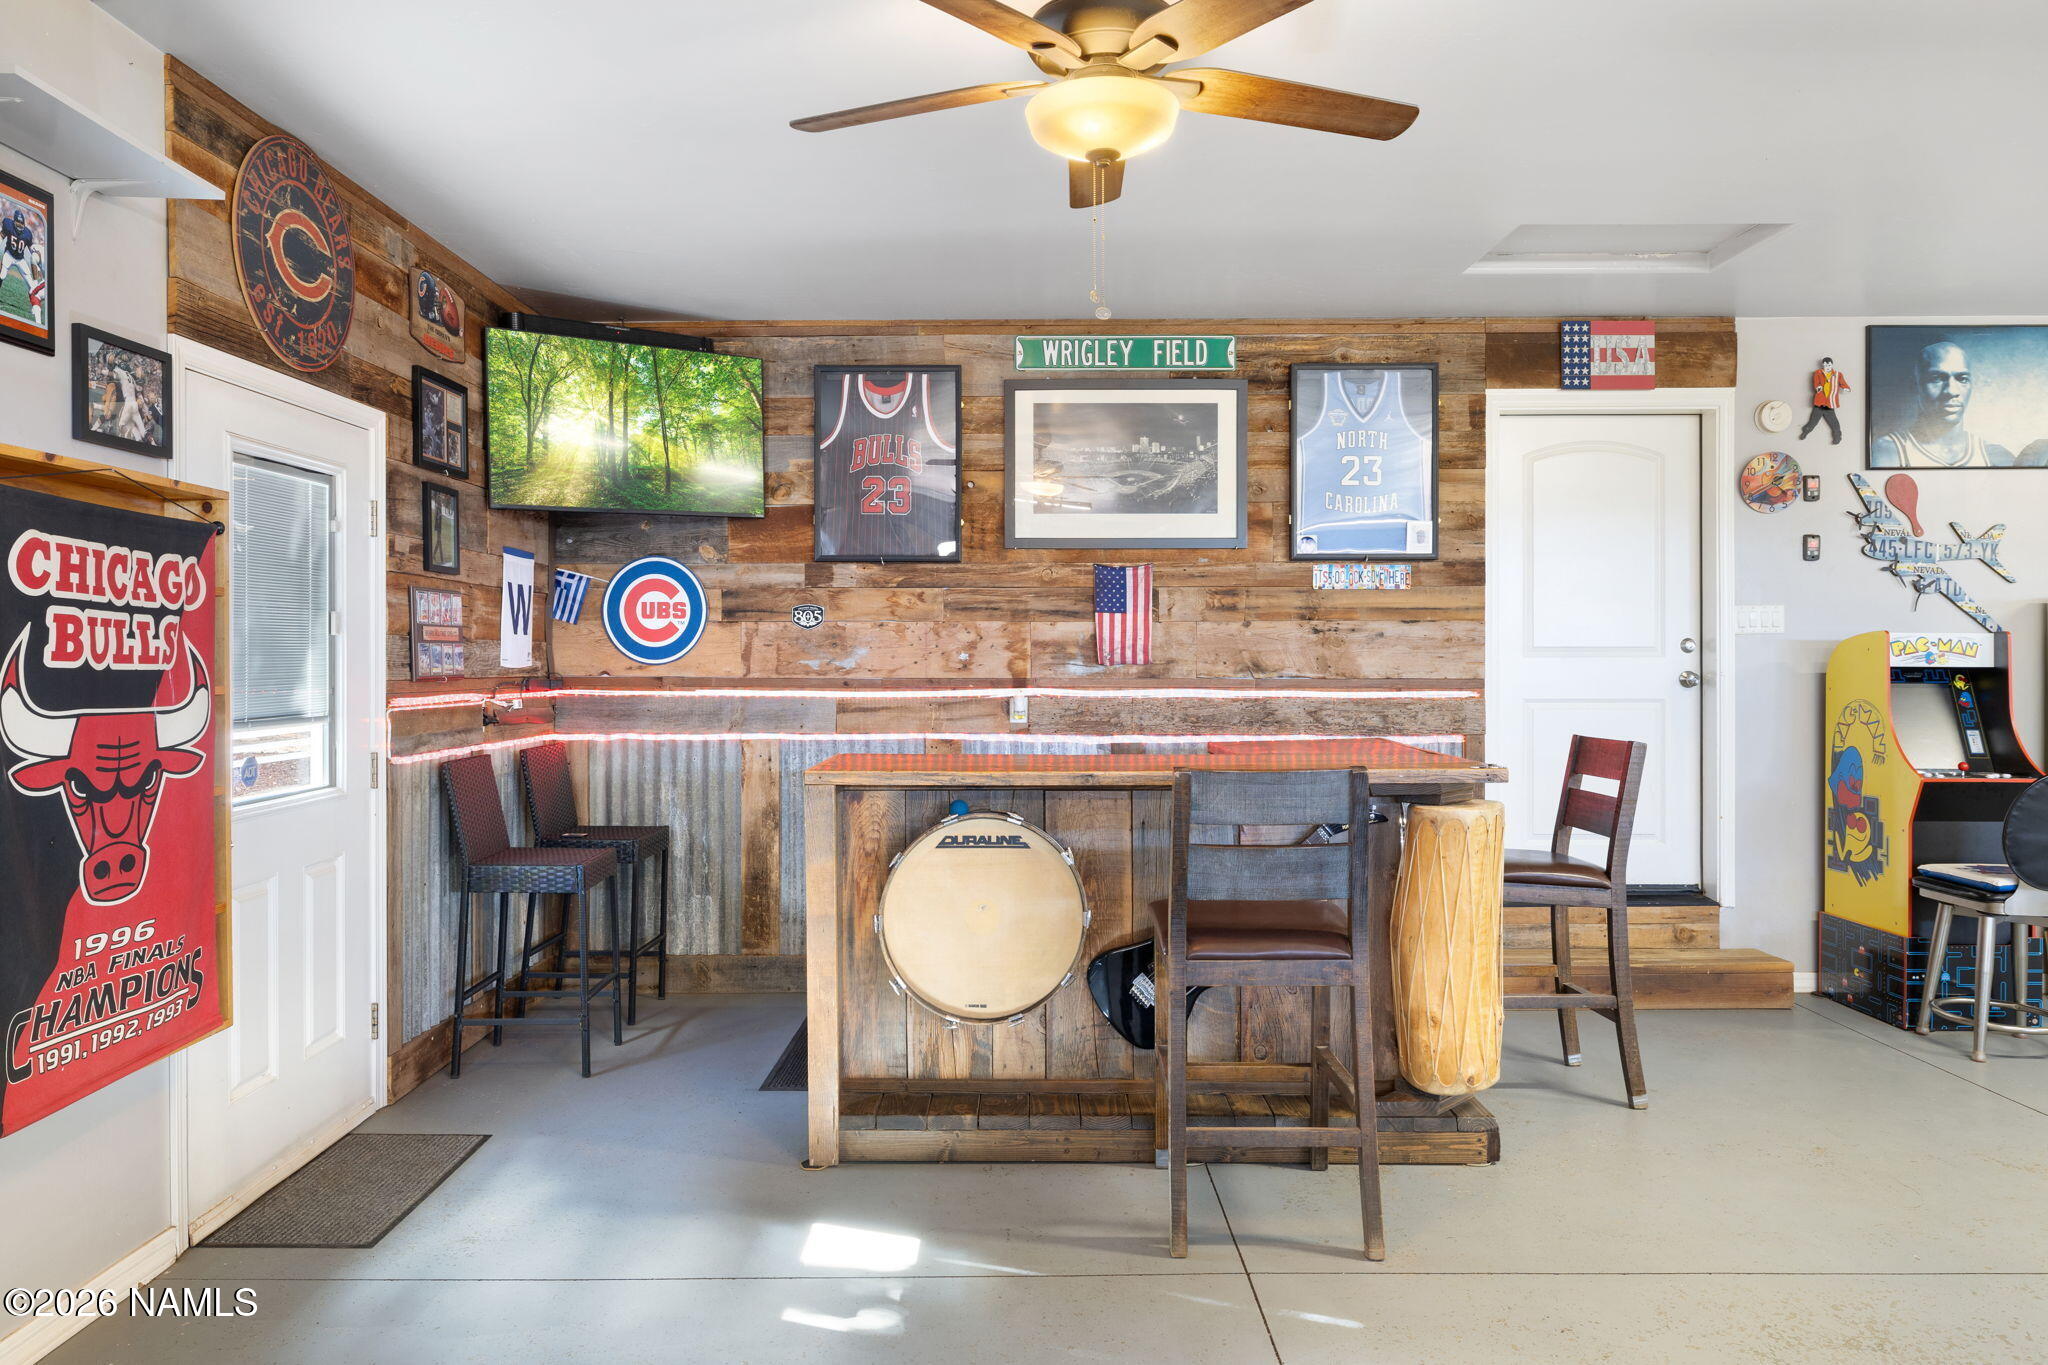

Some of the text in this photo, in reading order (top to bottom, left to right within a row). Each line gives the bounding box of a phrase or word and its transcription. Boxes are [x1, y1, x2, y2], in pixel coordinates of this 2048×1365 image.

[242, 149, 308, 215] CHICAGO
[313, 174, 352, 270] BEARS
[11, 235, 25, 253] 50
[266, 208, 333, 303] C
[1042, 339, 1208, 367] WRIGLEY FIELD
[1591, 334, 1651, 376] USA
[850, 433, 923, 475] BULLS
[1336, 430, 1389, 450] NORTH
[1769, 453, 1778, 462] 12
[1340, 455, 1384, 487] 23
[1746, 467, 1756, 476] 10
[1756, 457, 1766, 467] 11
[861, 475, 912, 516] 23
[1325, 490, 1399, 515] CAROLINA
[8, 529, 206, 612] CHICAGO
[508, 581, 532, 636] W
[623, 578, 687, 643] CUBS
[793, 610, 823, 623] 805
[44, 604, 181, 671] BULLS
[1890, 636, 1979, 658] PAC-MAN
[936, 835, 1031, 849] DURALINE
[74, 918, 157, 961] 1996
[55, 934, 186, 993] NBA FINALS
[6, 946, 205, 1085] CHAMPIONS
[37, 998, 183, 1075] 1991, 1992, 1993
